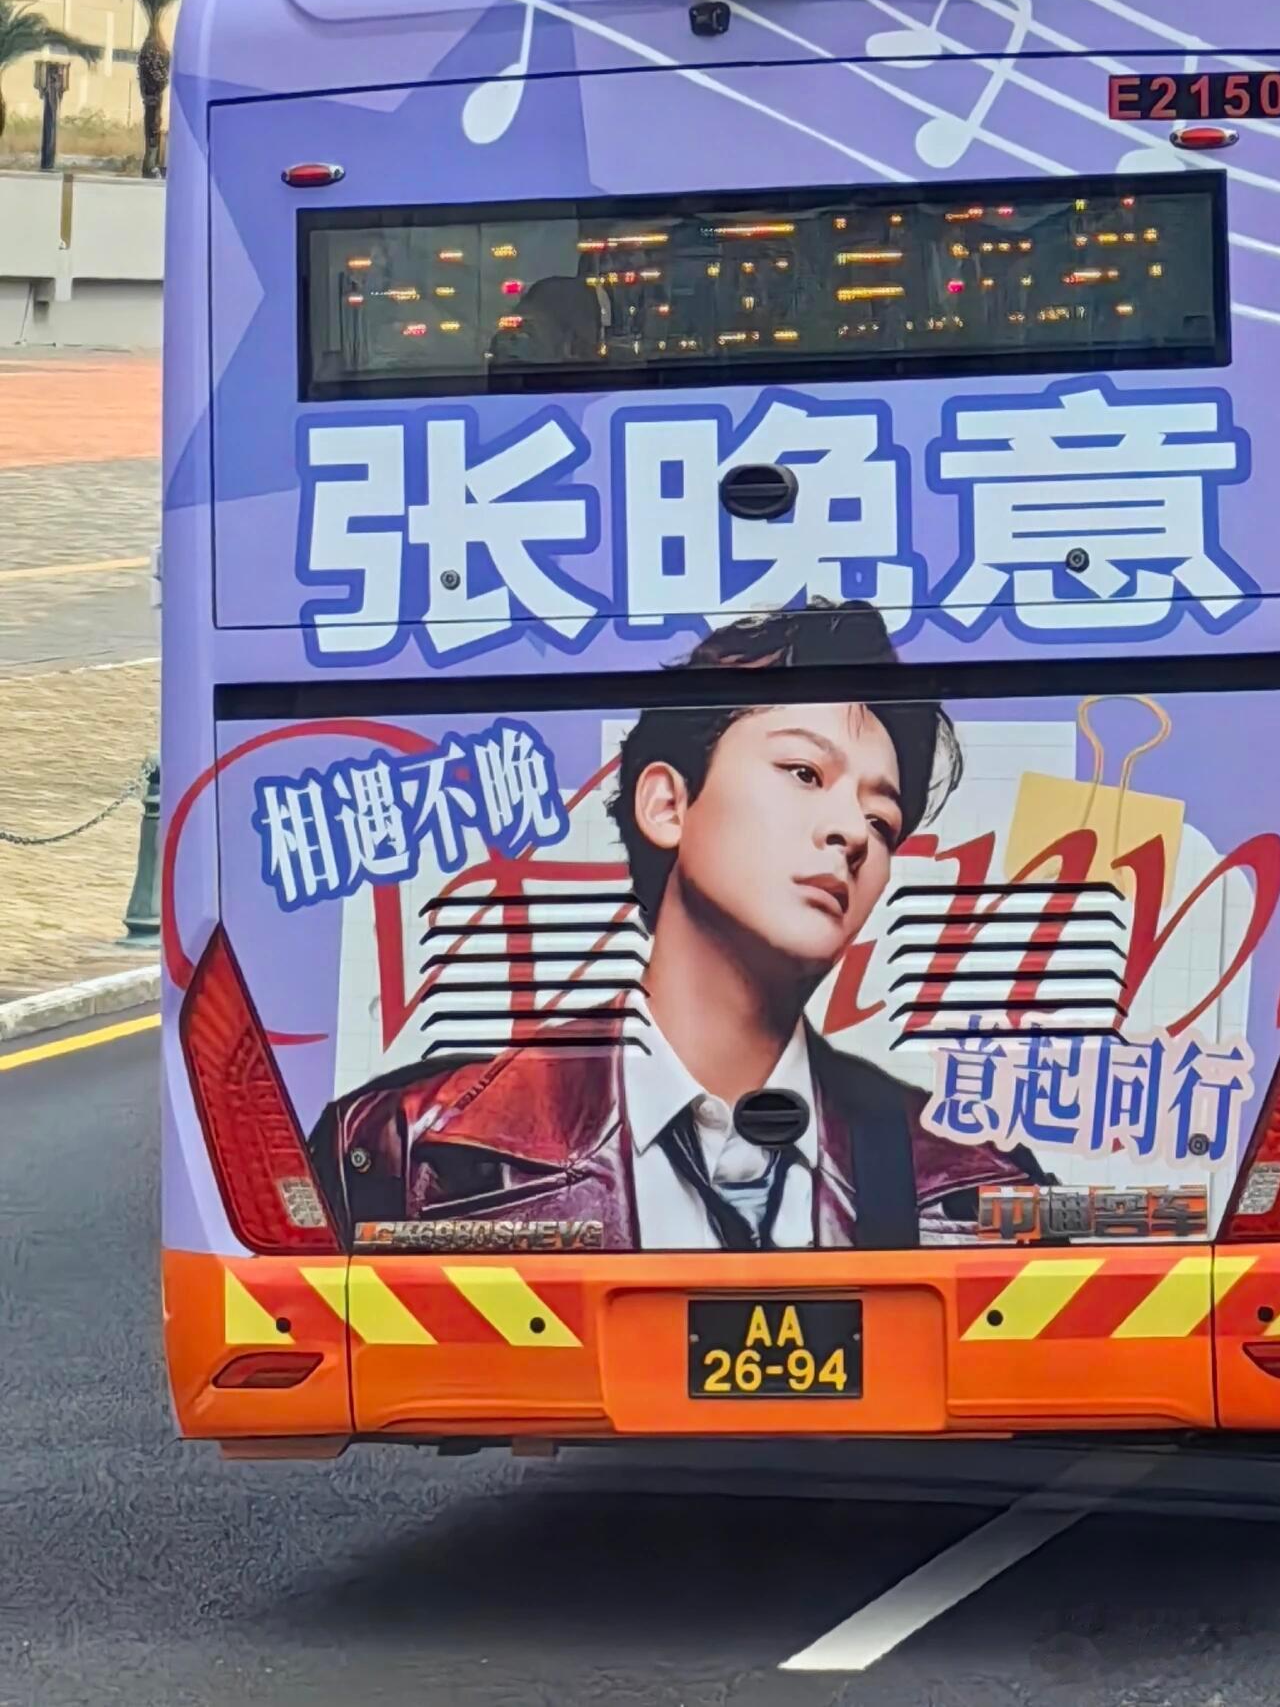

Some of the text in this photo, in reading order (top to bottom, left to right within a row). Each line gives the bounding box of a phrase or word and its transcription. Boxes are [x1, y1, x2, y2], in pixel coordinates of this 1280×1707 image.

[306, 387, 1247, 656] 张晚意
[260, 724, 561, 903] 相遇不晚
[930, 1012, 1244, 1161] 意起同行
[703, 1348, 848, 1392] 26-94
[745, 1305, 804, 1347] AA
